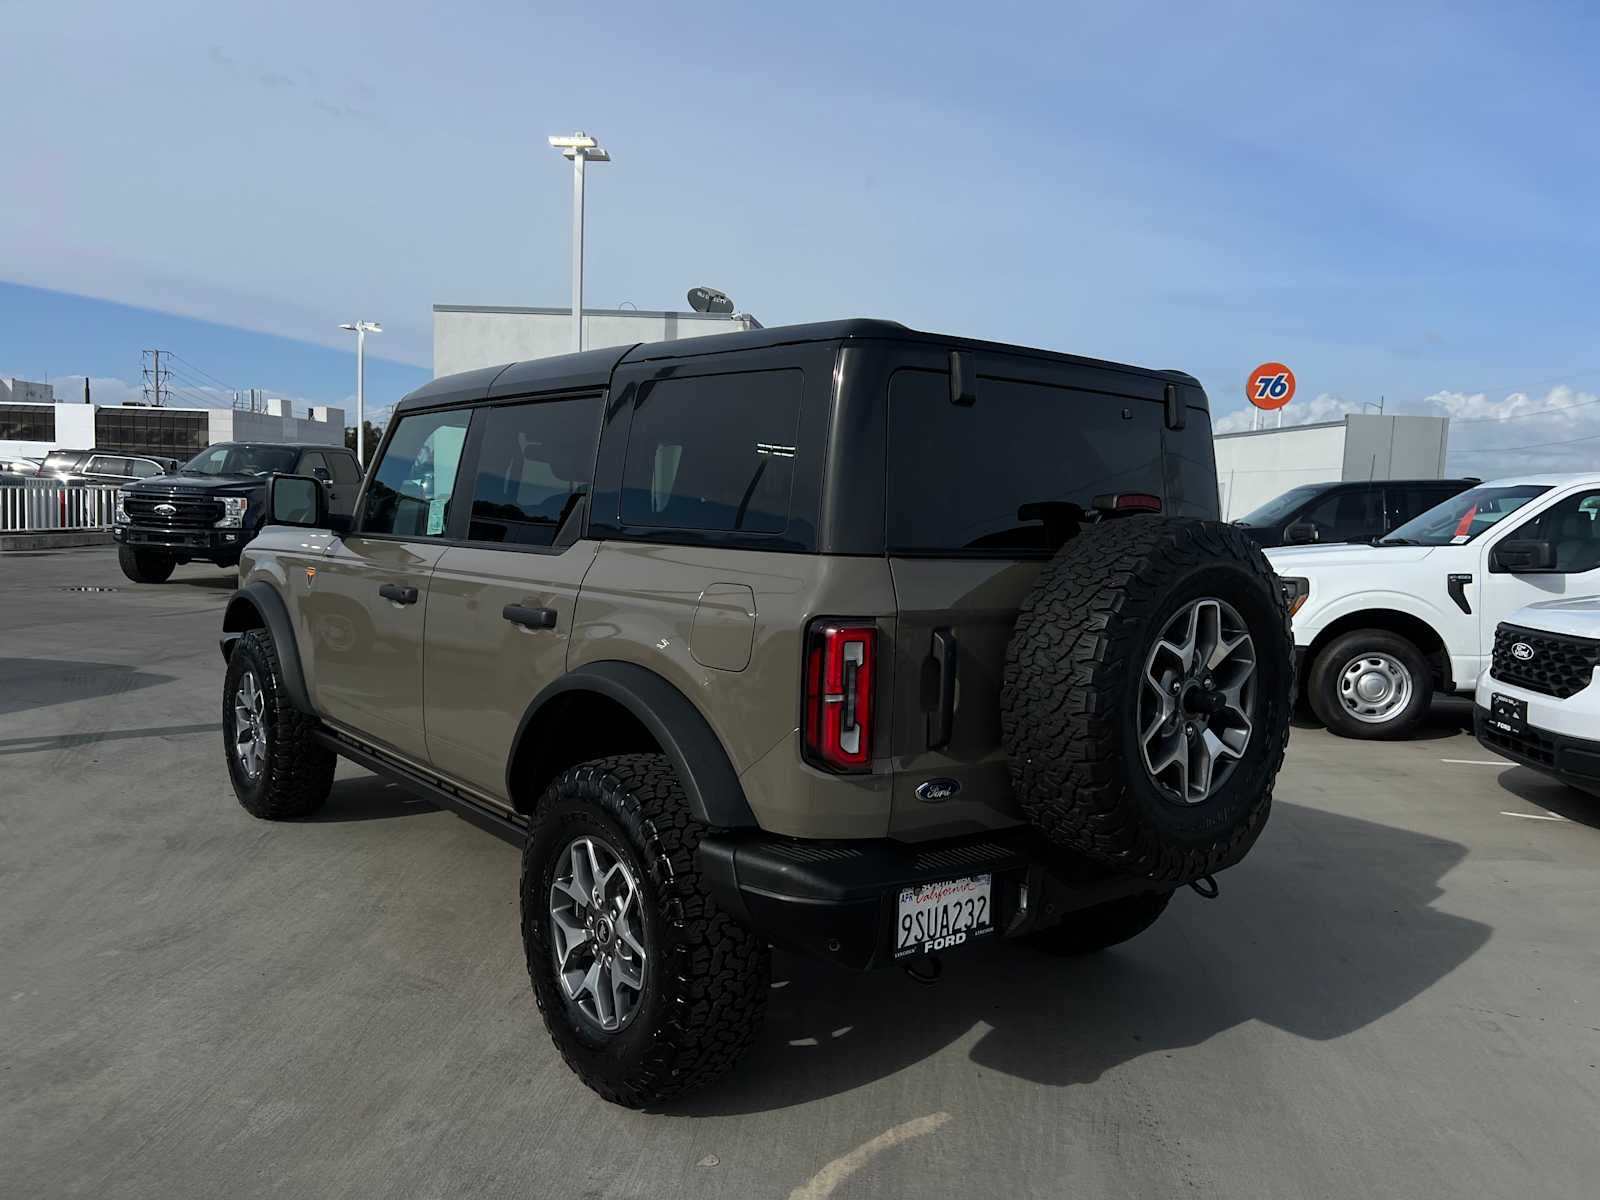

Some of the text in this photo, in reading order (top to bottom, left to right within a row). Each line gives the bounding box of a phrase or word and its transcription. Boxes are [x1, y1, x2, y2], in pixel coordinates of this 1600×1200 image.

[1255, 373, 1289, 399] 76
[916, 883, 977, 903] California
[901, 895, 987, 949] 9SUA232
[924, 932, 967, 954] FORD
